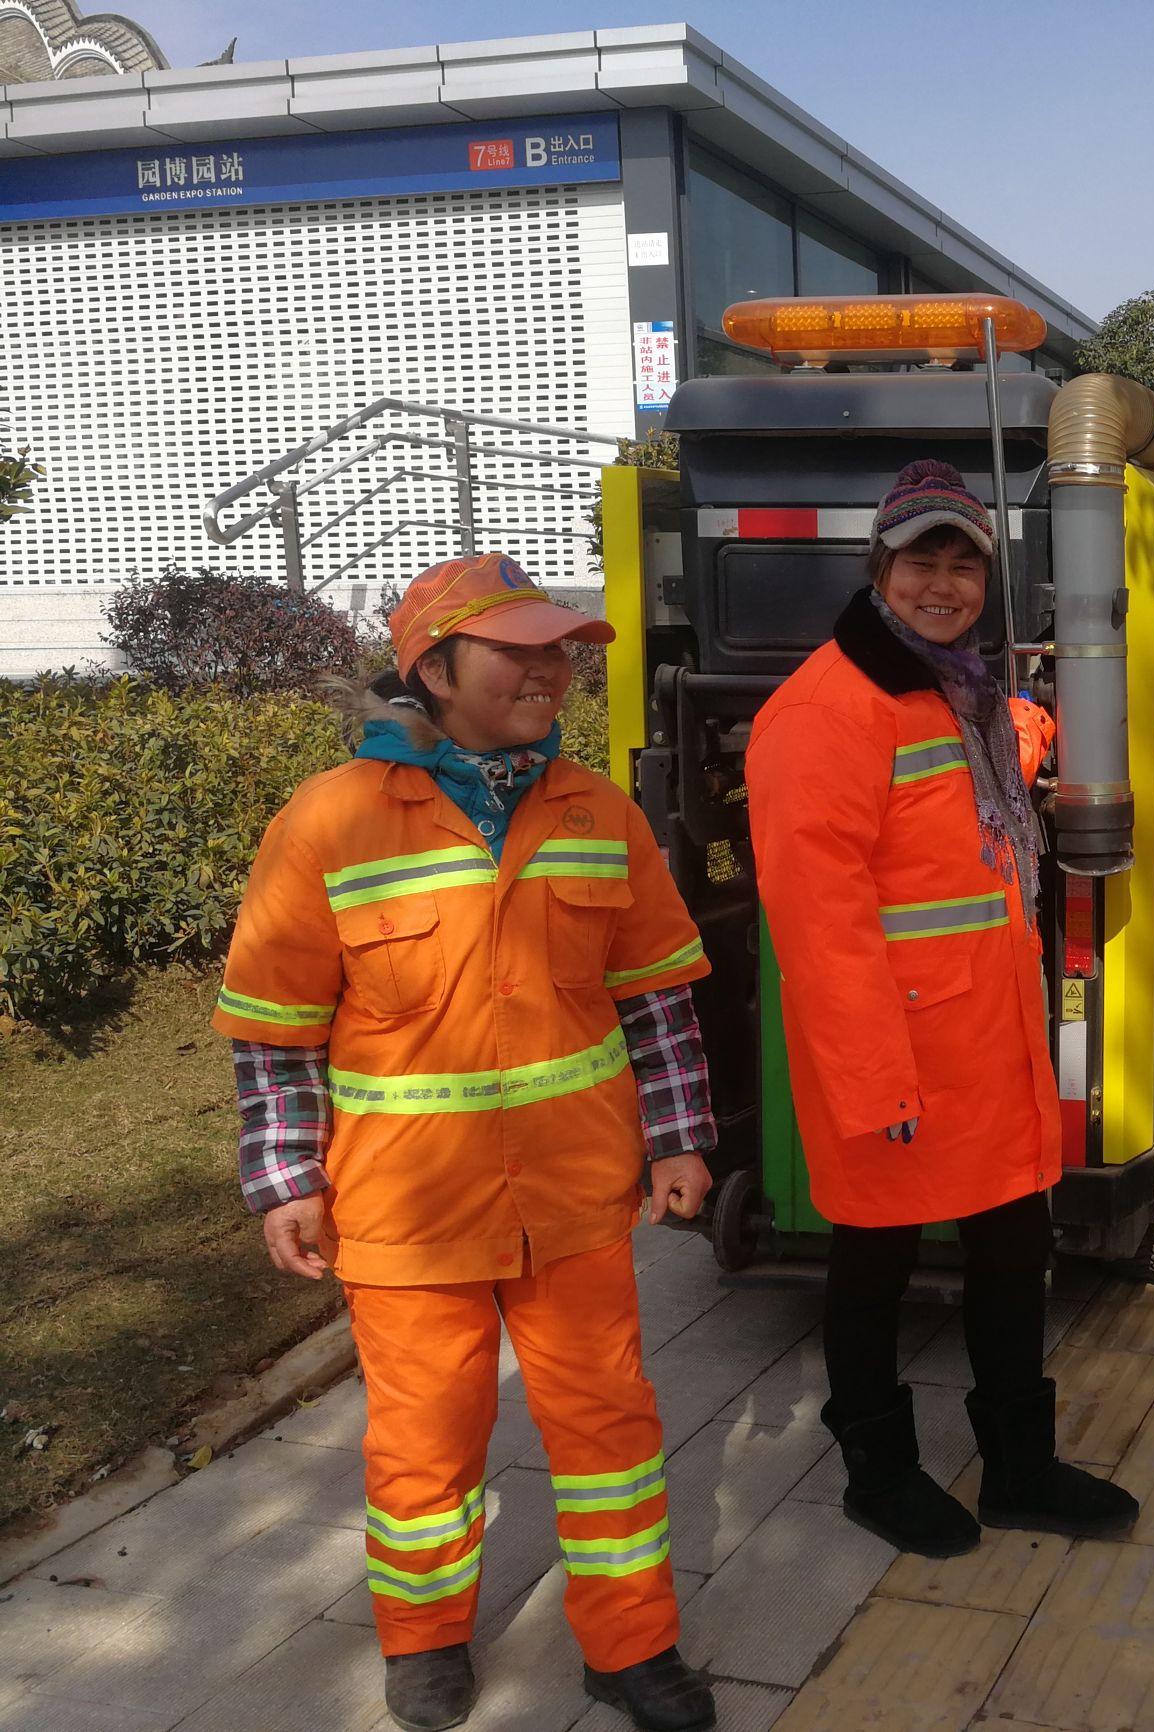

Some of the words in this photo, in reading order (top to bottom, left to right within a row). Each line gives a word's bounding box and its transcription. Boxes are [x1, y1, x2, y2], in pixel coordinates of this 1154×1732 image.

[473, 144, 510, 167] 7号线
[525, 137, 548, 167] B
[550, 134, 593, 152] 出入口
[137, 152, 244, 189] 园博园站
[552, 154, 595, 166] Entrance
[142, 191, 178, 202] GARDEN
[180, 189, 204, 199] EXPO
[206, 187, 243, 197] STATION
[639, 336, 655, 401] 非站内施工人员
[655, 336, 672, 401] 禁止进入
